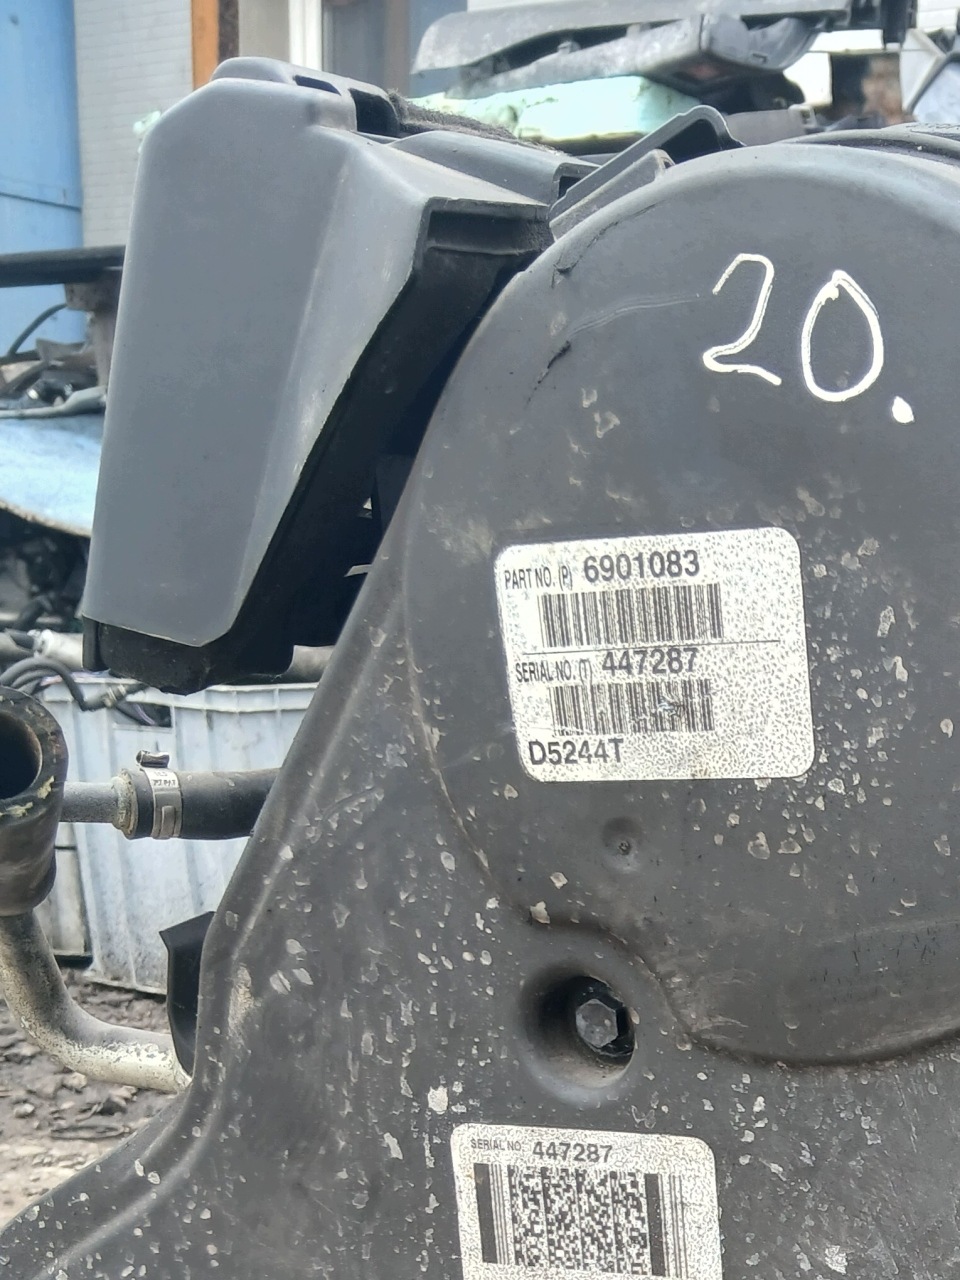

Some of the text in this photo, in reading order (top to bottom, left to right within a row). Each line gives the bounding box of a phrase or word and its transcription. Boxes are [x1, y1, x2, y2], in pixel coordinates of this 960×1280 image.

[504, 550, 700, 591] PART NO. (P) 6901083
[515, 648, 699, 685] SERIAL NO. (T) 447287
[528, 738, 624, 766] D5244T
[470, 1138, 506, 1151] SERIAL
[533, 1141, 613, 1163] 447287
